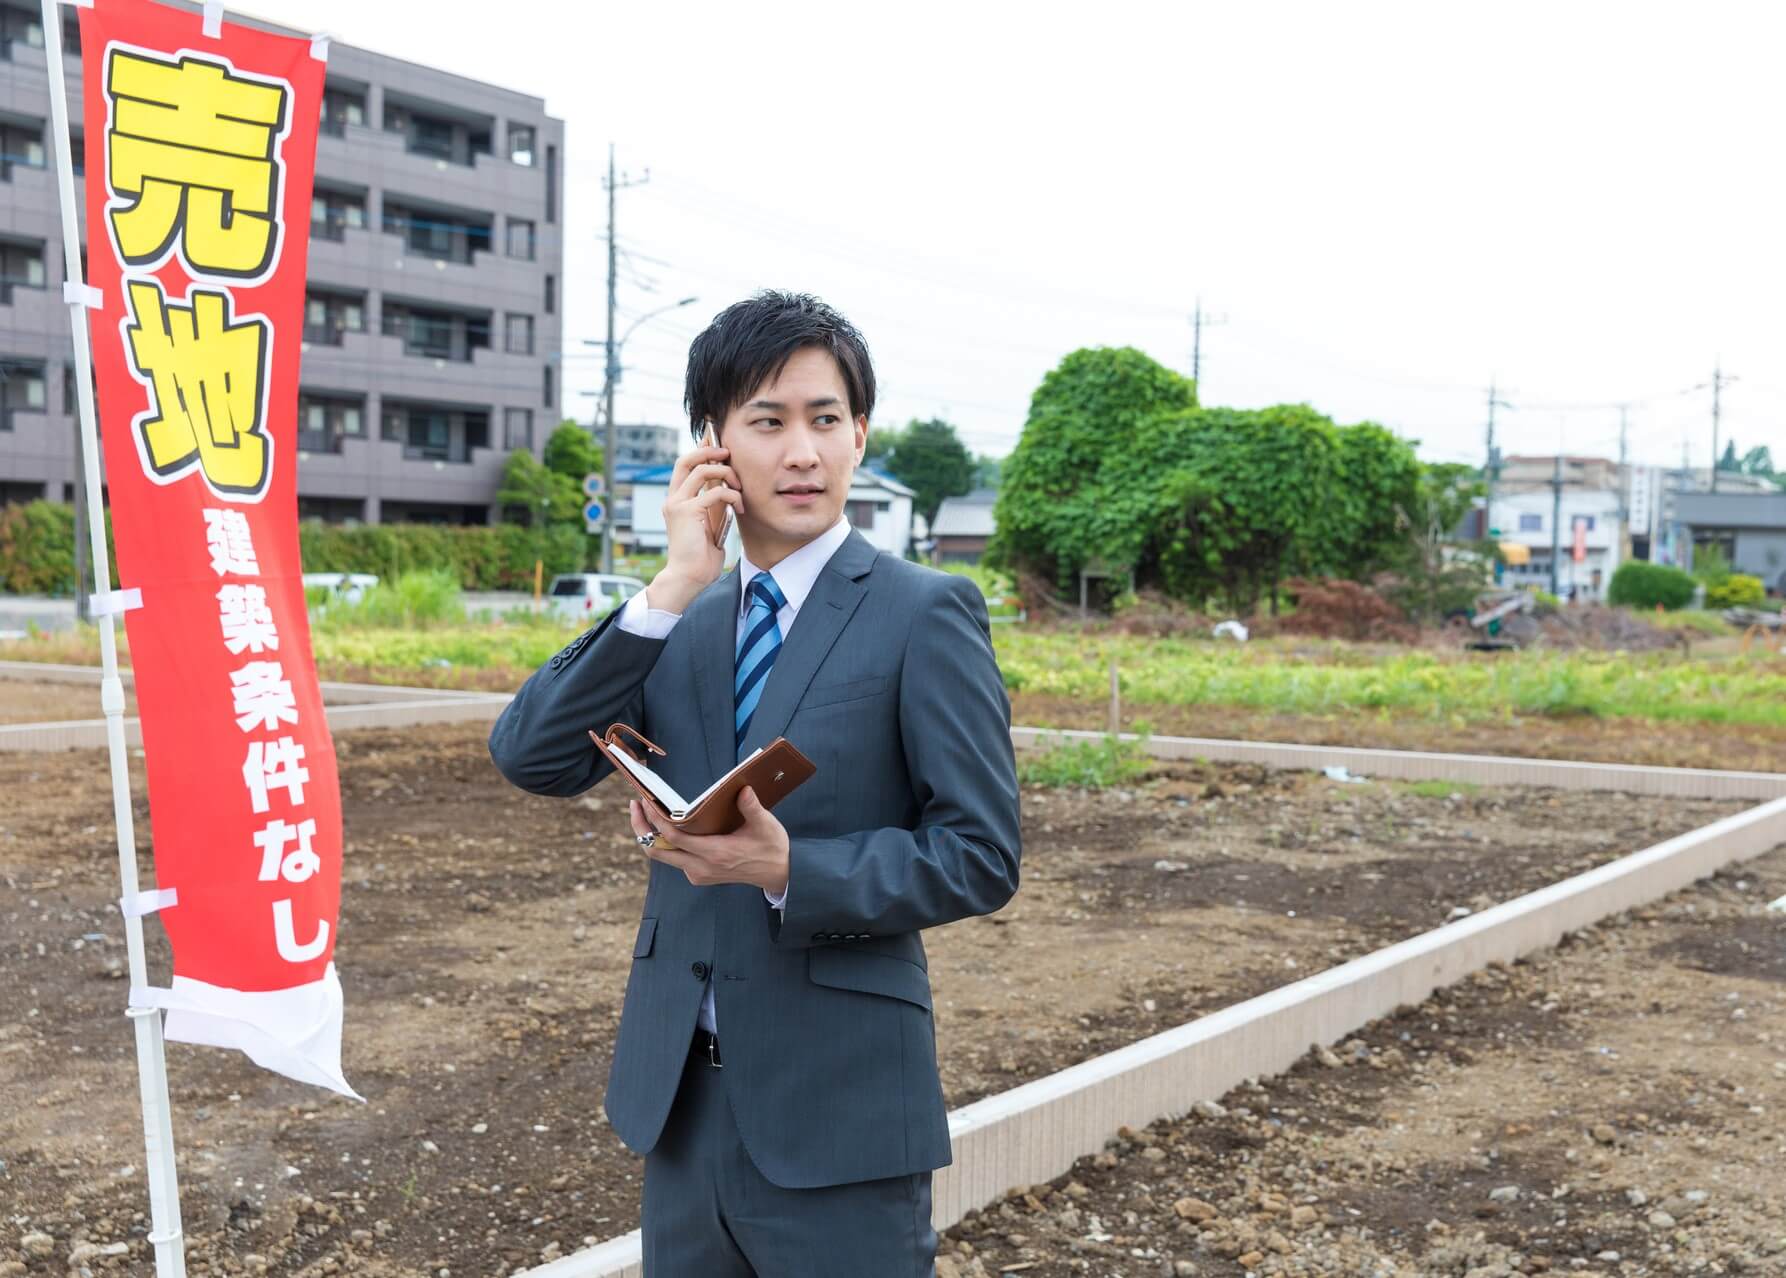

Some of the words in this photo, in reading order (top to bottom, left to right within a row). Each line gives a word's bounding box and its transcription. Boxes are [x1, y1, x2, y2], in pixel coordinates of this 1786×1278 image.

[105, 42, 292, 501] 売地
[203, 508, 330, 963] 建築条件なし
